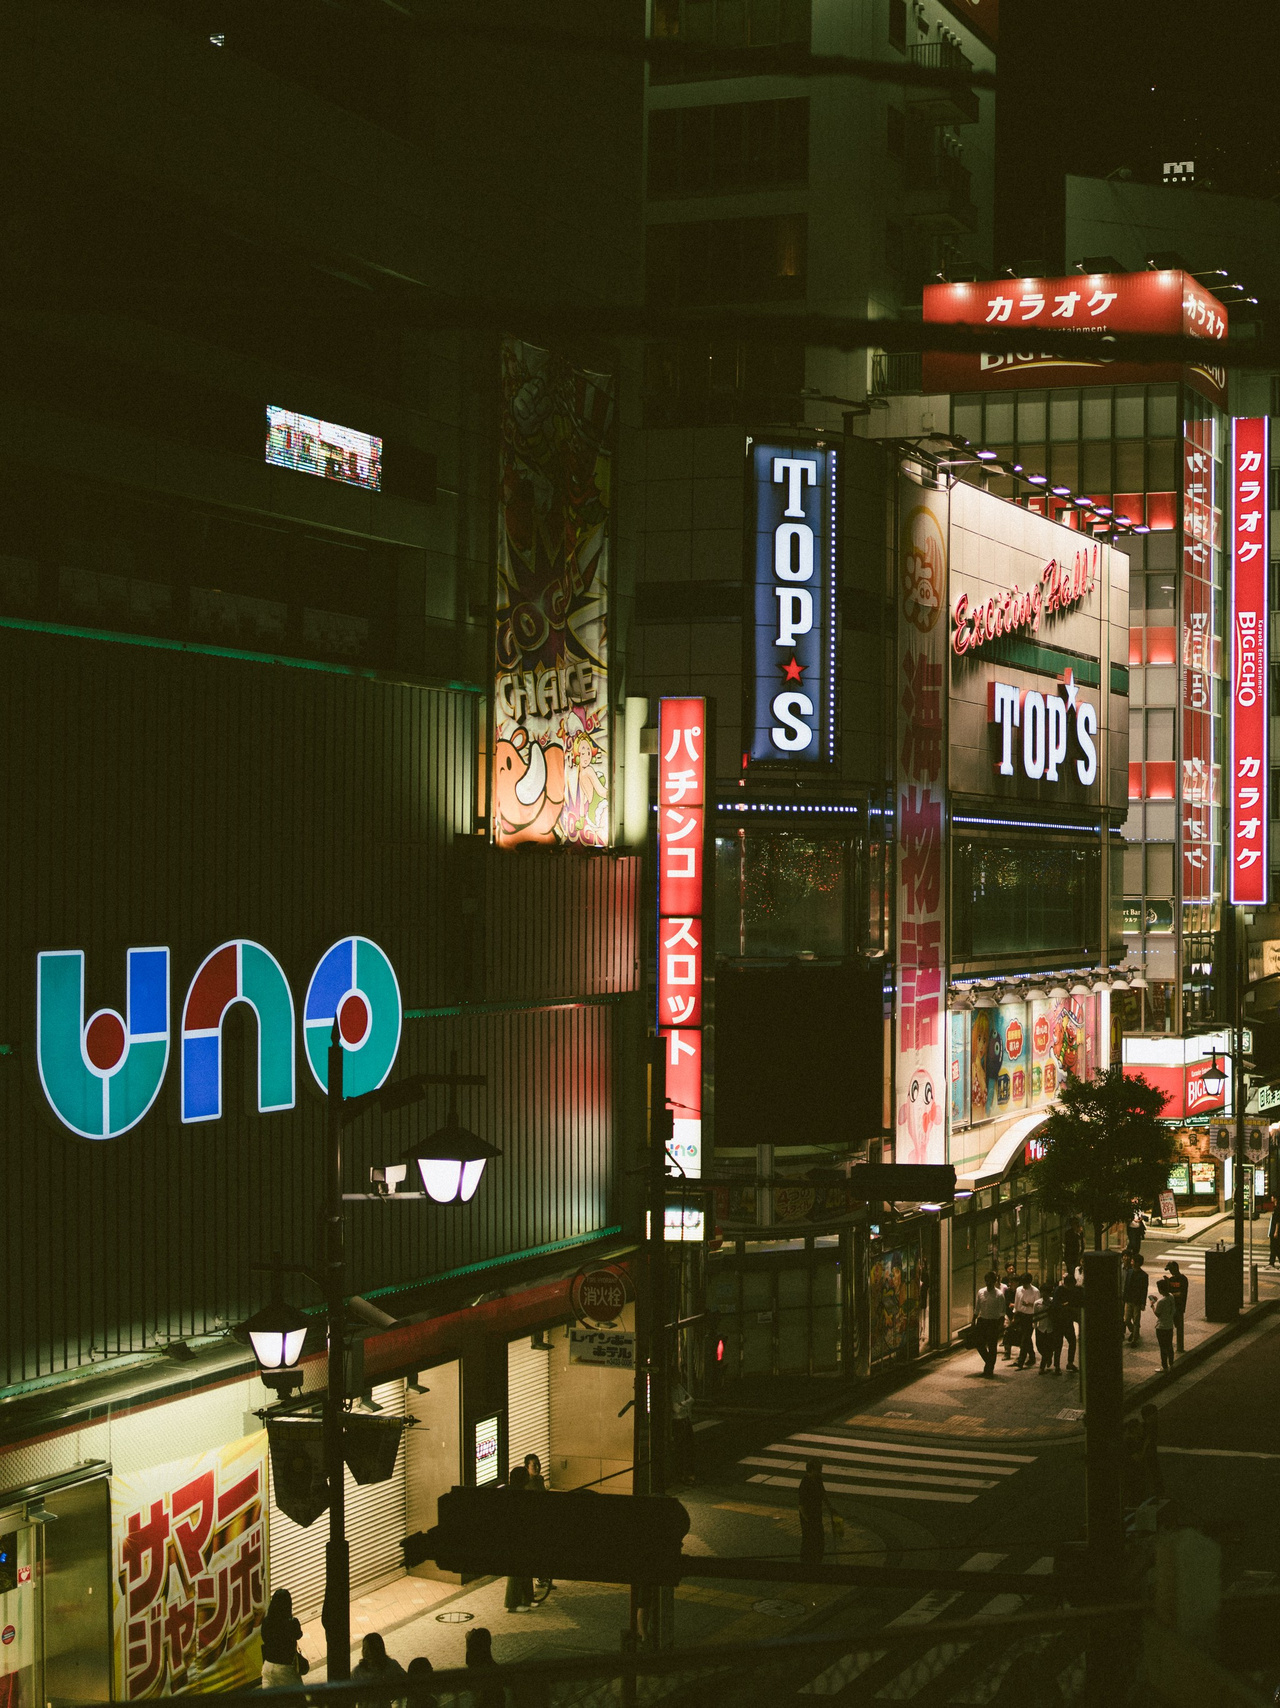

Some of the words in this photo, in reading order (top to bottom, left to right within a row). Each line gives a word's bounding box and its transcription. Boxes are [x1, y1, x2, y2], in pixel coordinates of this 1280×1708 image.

[985, 291, 1118, 322] カラオケ
[1187, 293, 1225, 340] カラオケ
[1238, 451, 1262, 563] カラオケ
[954, 584, 1042, 656] Exciting
[1042, 543, 1098, 614] Hall!
[1239, 611, 1257, 649] BIG
[1239, 652, 1257, 707] ECHO
[664, 725, 701, 878] パチンコ
[1237, 756, 1262, 870] カラオケ
[900, 652, 944, 1053] 海物語
[664, 917, 698, 1067] スロット
[1188, 1079, 1203, 1108] BIG
[583, 1286, 622, 1307] 消火栓
[571, 1331, 633, 1346] レインボー
[592, 1346, 632, 1359] ホテル
[122, 1467, 260, 1620] サマー
[128, 1528, 263, 1700] ジャンボ
